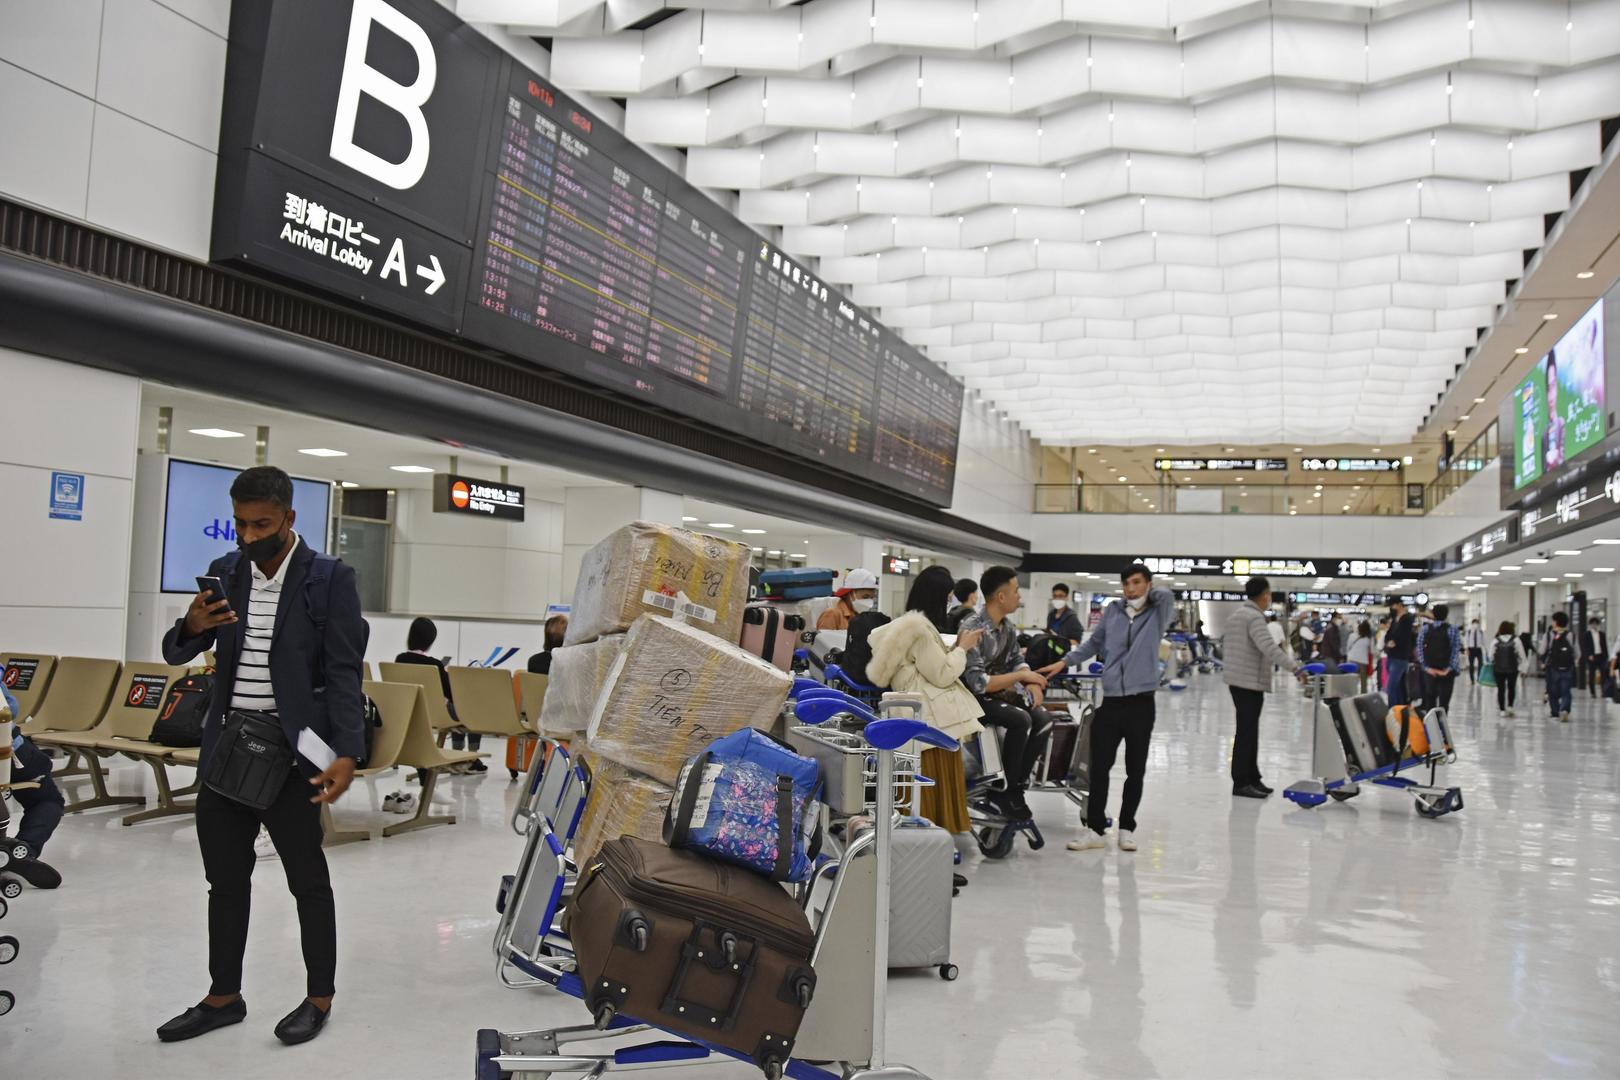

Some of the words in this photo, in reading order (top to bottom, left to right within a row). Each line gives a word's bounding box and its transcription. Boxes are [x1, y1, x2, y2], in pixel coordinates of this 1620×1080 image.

[330, 0, 437, 190] B
[283, 192, 380, 246] 到着ロビー
[379, 237, 408, 287] A
[280, 222, 329, 256] Arrival
[331, 241, 373, 275] Lobby
[483, 283, 506, 299] 13:55
[482, 296, 504, 311] 14:25
[470, 500, 479, 510] No
[480, 501, 495, 514] Entry
[248, 742, 266, 751] Jeep
